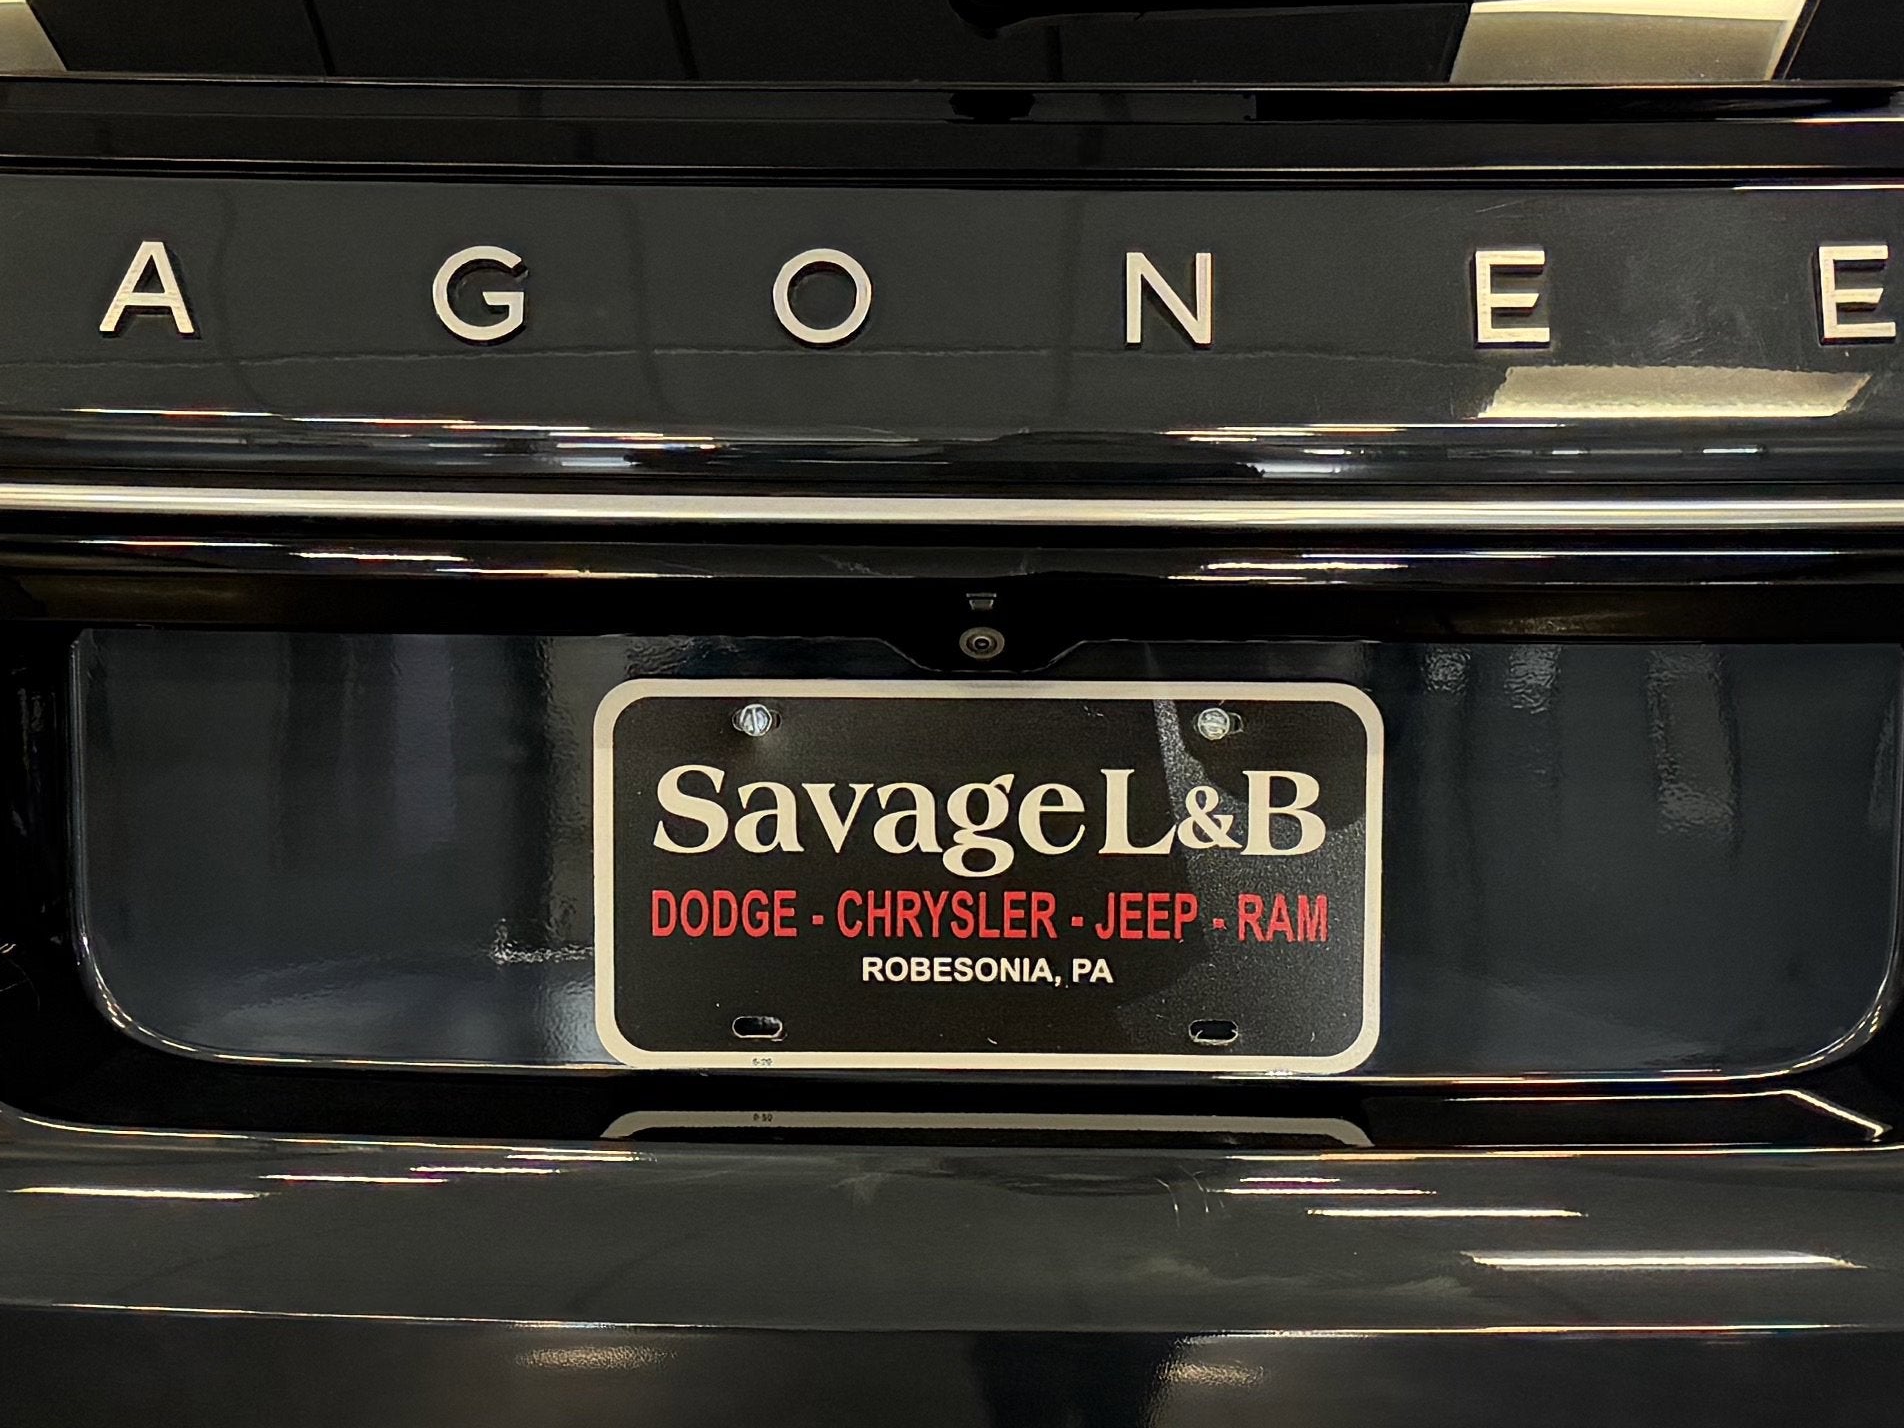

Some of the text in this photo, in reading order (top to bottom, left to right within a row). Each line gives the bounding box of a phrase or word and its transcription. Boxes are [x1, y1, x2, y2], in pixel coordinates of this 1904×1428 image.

[651, 888, 797, 938] DODGE
[837, 888, 1058, 939] CHRYSLER
[1095, 891, 1198, 941] JEEP
[1237, 892, 1330, 944] RAM
[861, 955, 1114, 987] ROBESONIA, PA
